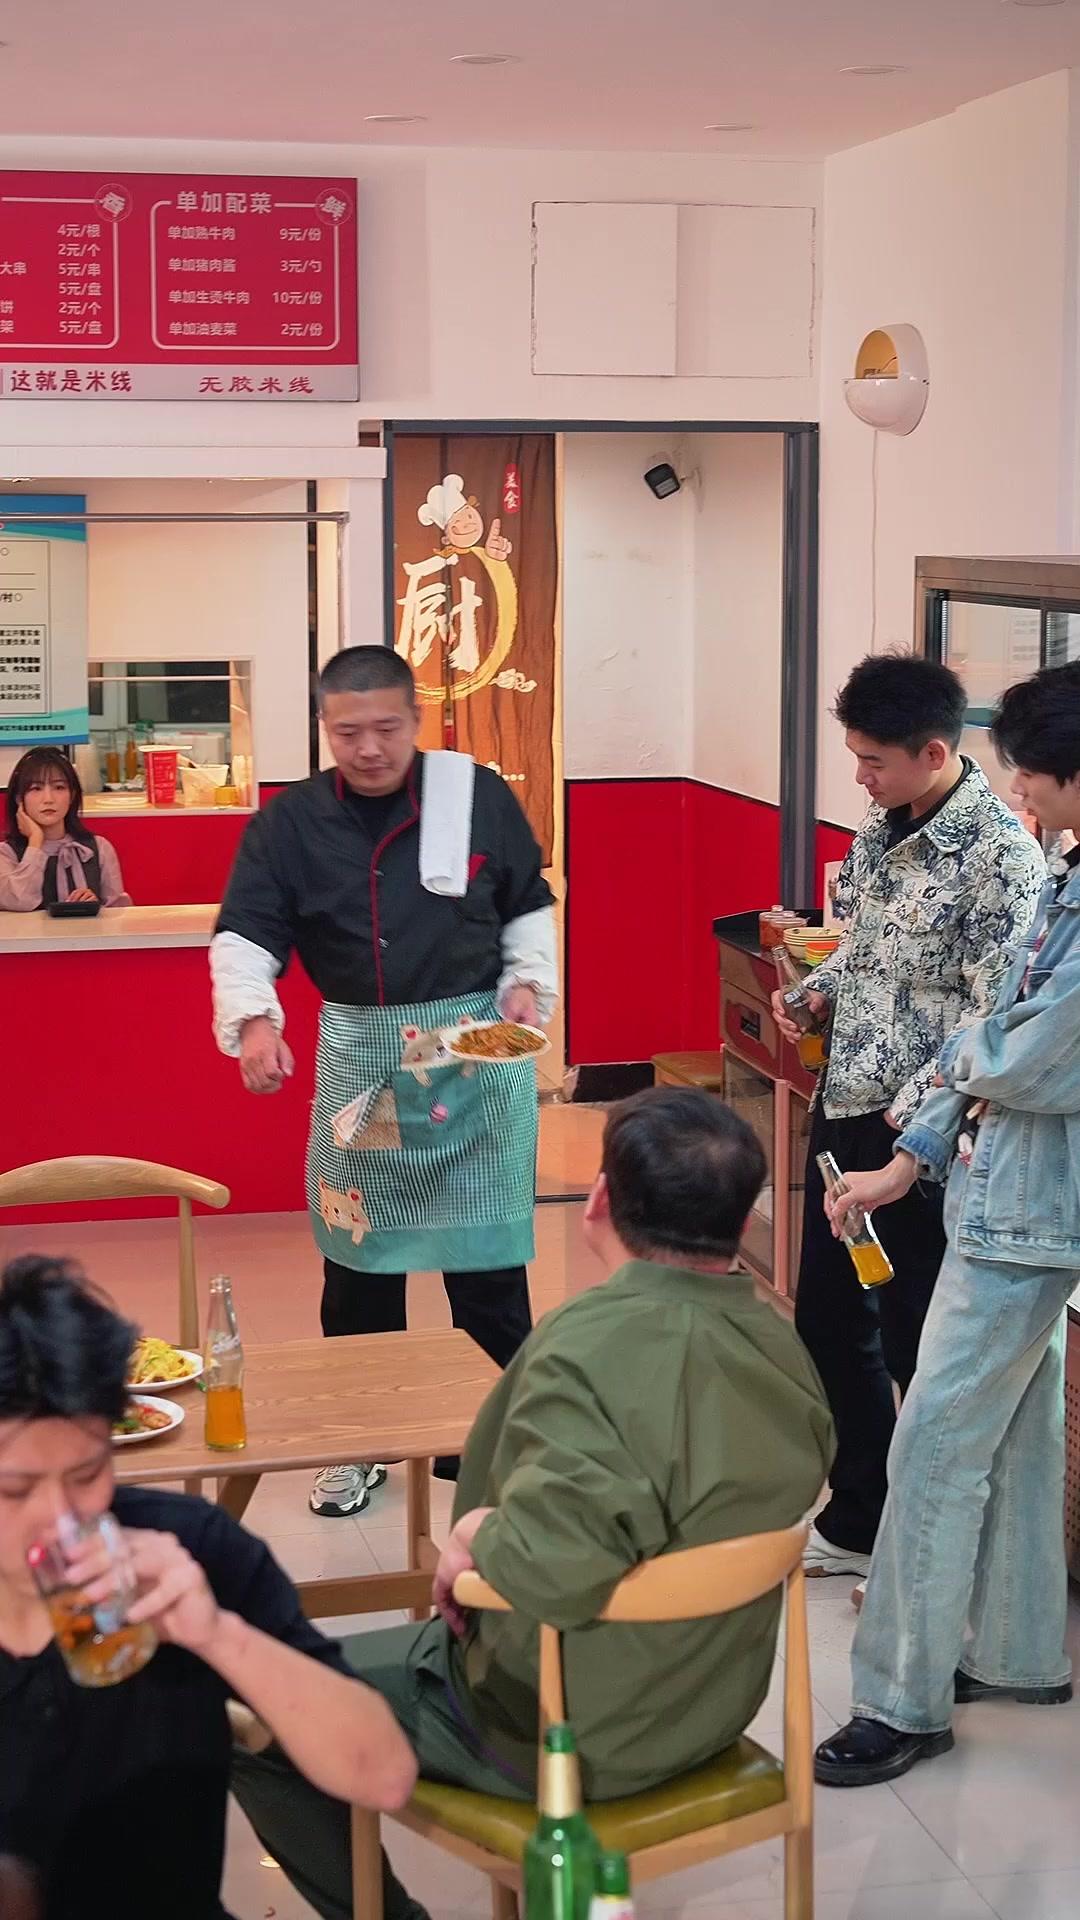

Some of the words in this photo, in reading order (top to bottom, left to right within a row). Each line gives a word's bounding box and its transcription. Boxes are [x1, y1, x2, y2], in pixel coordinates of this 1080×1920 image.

[176, 191, 272, 214] 单加配菜
[57, 223, 101, 238] 4元/根
[279, 228, 322, 241] 9元/份
[58, 243, 101, 257] 2元/个
[0, 262, 27, 275] 大串
[58, 263, 101, 276] 5元/串
[168, 258, 237, 273] 单加猪肉酱
[280, 259, 322, 273] 3元/勺
[168, 290, 250, 305] 单加生烫牛肉
[272, 291, 323, 305] 10元/份
[58, 301, 102, 315] 2元/个
[168, 322, 238, 336] 单加油麦菜
[281, 323, 323, 337] 2元/份
[11, 370, 132, 392] 这就是米线
[199, 376, 314, 393] 无胶米线
[503, 472, 519, 508] 美食
[394, 554, 483, 673] 厨
